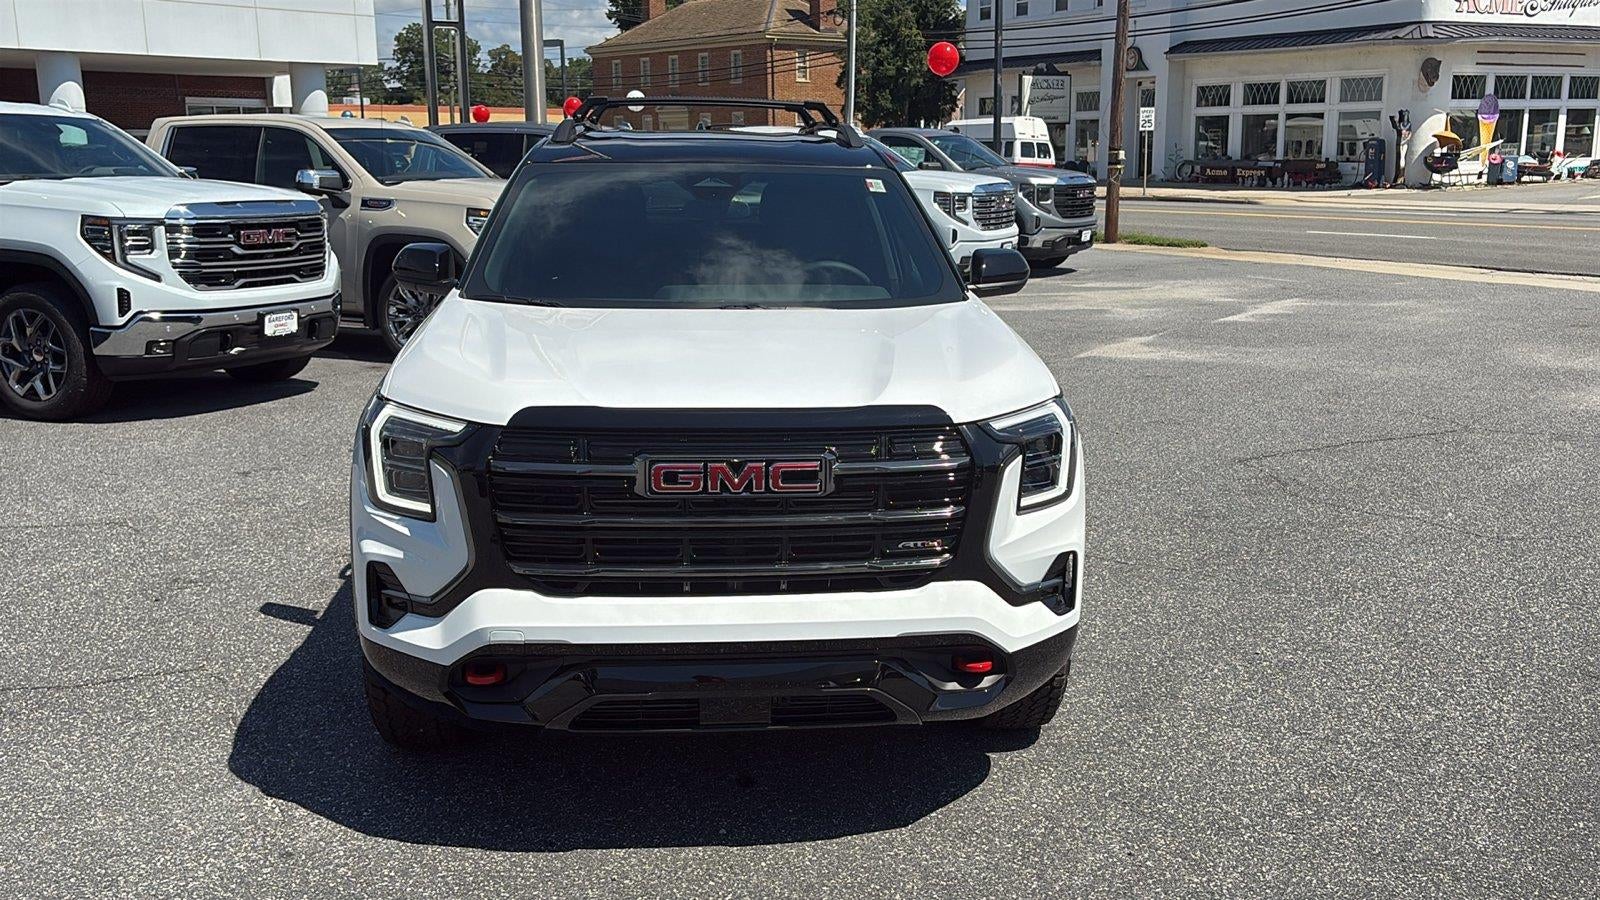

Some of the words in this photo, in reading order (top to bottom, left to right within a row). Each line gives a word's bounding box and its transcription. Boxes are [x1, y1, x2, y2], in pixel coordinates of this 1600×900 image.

[1141, 119, 1153, 129] 25
[1205, 168, 1228, 176] Acme
[1236, 168, 1265, 177] Express
[240, 228, 296, 245] GMC
[651, 462, 821, 493] GMC
